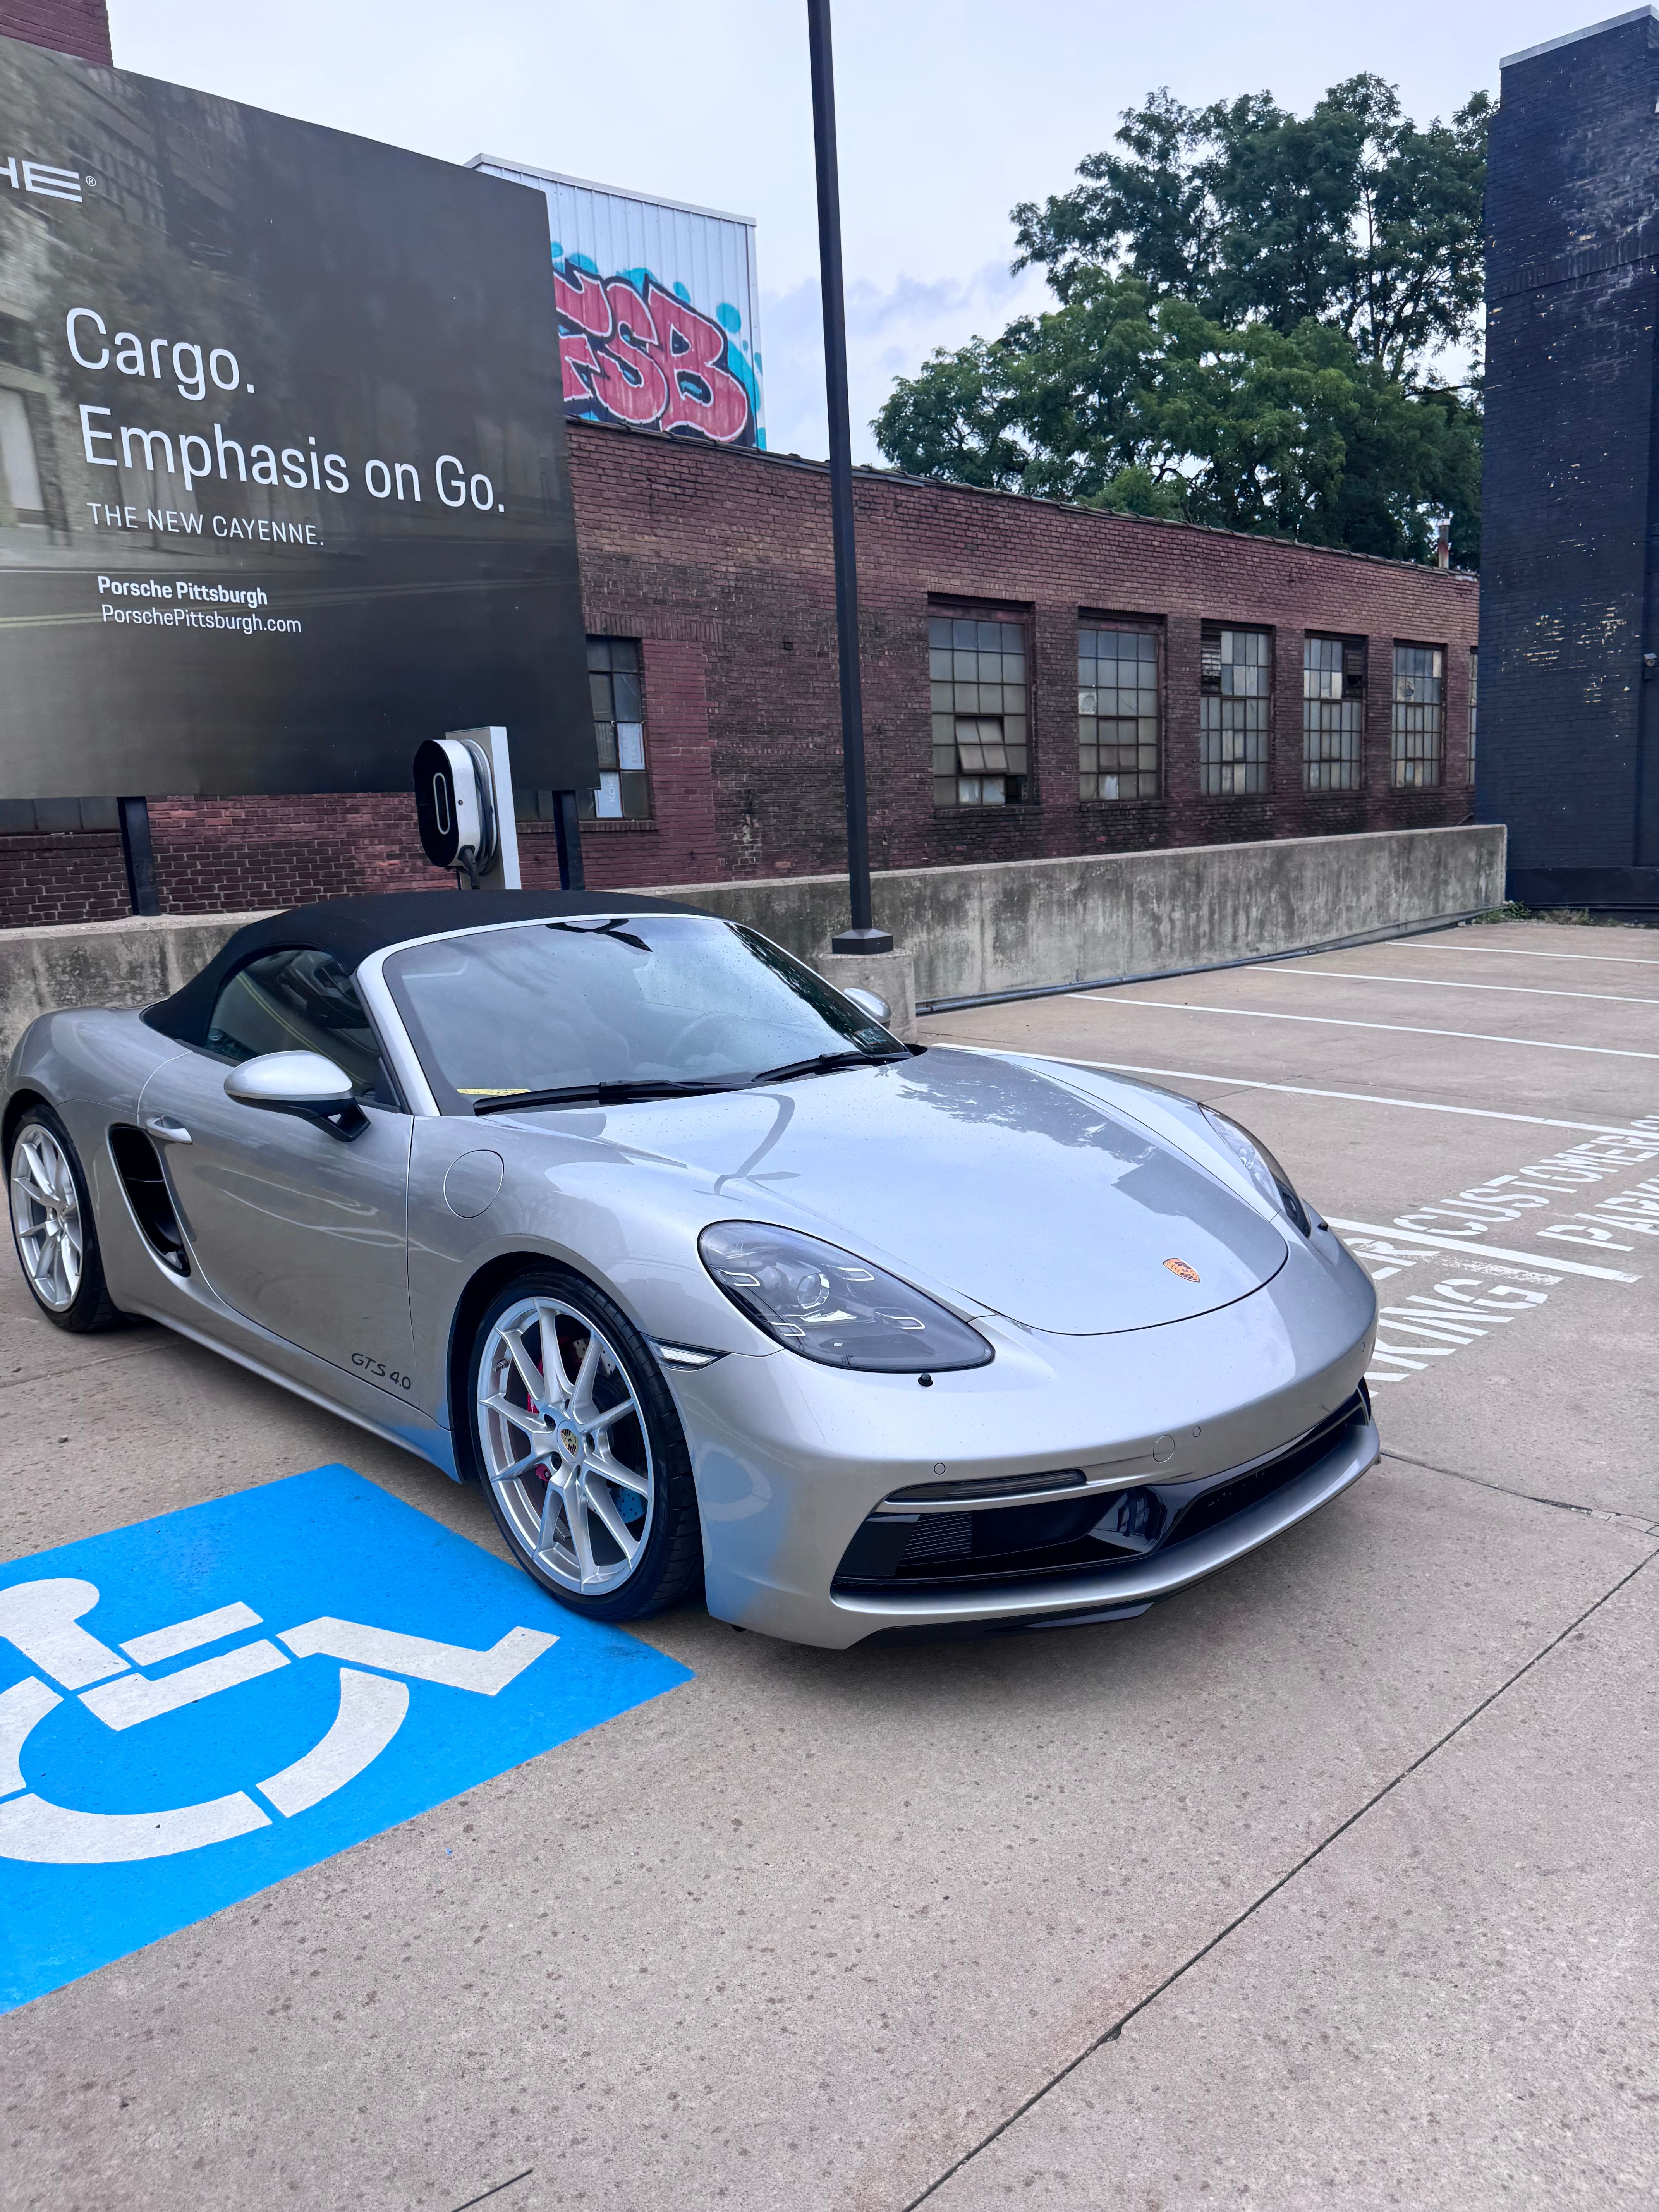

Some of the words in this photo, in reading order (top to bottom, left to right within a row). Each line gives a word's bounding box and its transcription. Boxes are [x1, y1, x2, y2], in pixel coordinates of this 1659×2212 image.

[67, 308, 254, 400] Cargo.
[79, 404, 349, 493] Emphasis
[366, 460, 421, 502] on
[436, 455, 504, 512] Go.
[86, 503, 138, 529] THE
[147, 508, 203, 534] NEW
[213, 516, 324, 546] CAYENNE.
[97, 575, 172, 599] Porsche
[175, 581, 268, 608] Pittsburgh
[101, 604, 301, 635] PorschePittsburgh.com
[1393, 1135, 1659, 1236] CUSTOMER
[351, 1353, 386, 1377] GTS
[390, 1372, 411, 1390] 4.0
